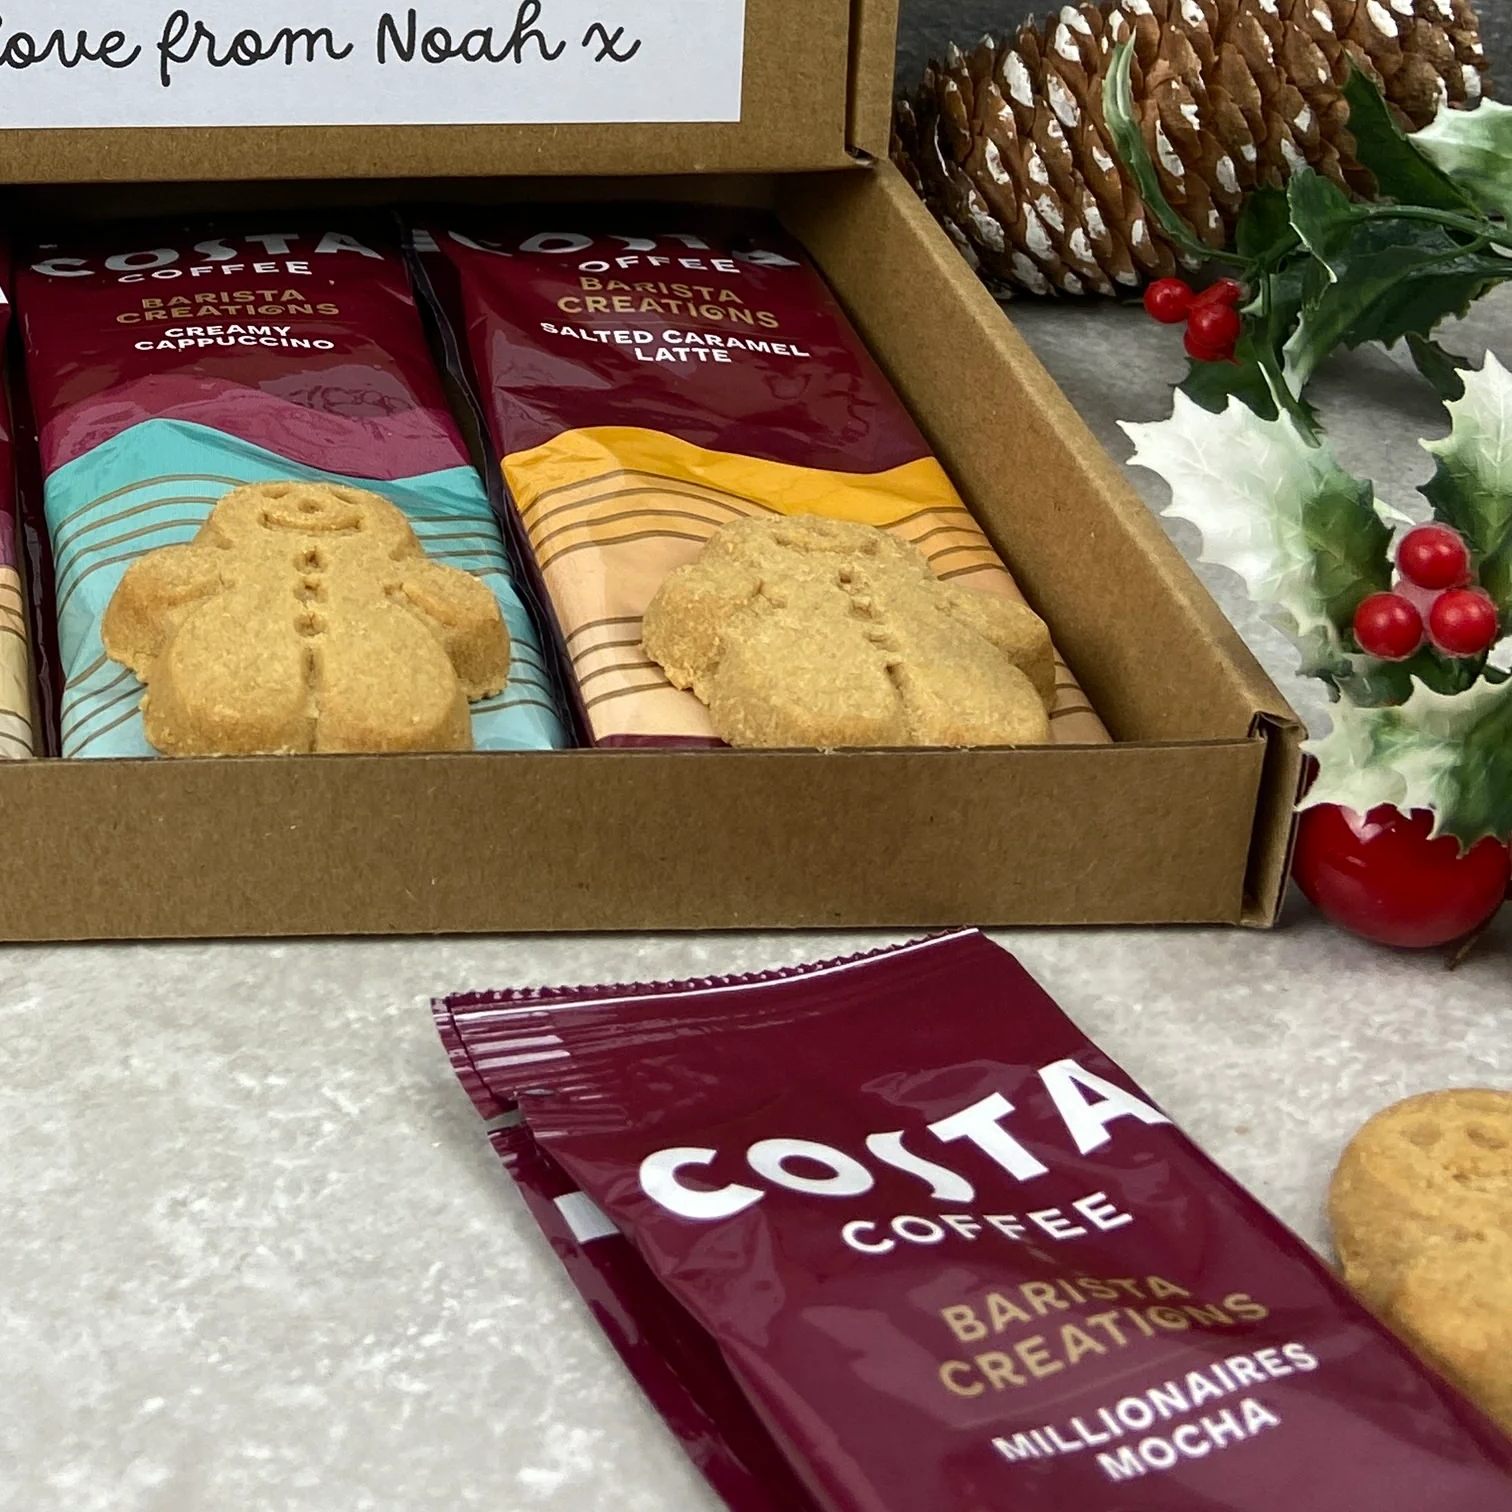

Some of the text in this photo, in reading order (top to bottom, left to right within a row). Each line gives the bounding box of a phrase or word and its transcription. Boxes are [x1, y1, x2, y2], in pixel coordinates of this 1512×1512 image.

[156, 9, 354, 88] from
[581, 19, 642, 65] x
[30, 231, 385, 278] COSTA
[577, 255, 742, 274] OFFEE
[117, 261, 313, 284] COFFEE
[141, 288, 307, 310] BARISTA
[579, 276, 744, 305] BARISTA
[116, 302, 340, 325] CREATIONS
[557, 296, 780, 330] CREATIONS
[134, 334, 336, 351] CAPPUCCINO
[163, 324, 293, 339] CREAMY
[540, 322, 811, 358] SALTED CARAMEL
[633, 346, 733, 364] LATTE
[635, 1056, 1175, 1222] COSTA
[840, 1190, 1135, 1257] COFFEE
[938, 1273, 1193, 1345] BARISTA
[935, 1291, 1270, 1399] CREATIONS
[991, 1340, 1321, 1465] MILLIONAIRES
[1094, 1398, 1283, 1484] MOCHA
